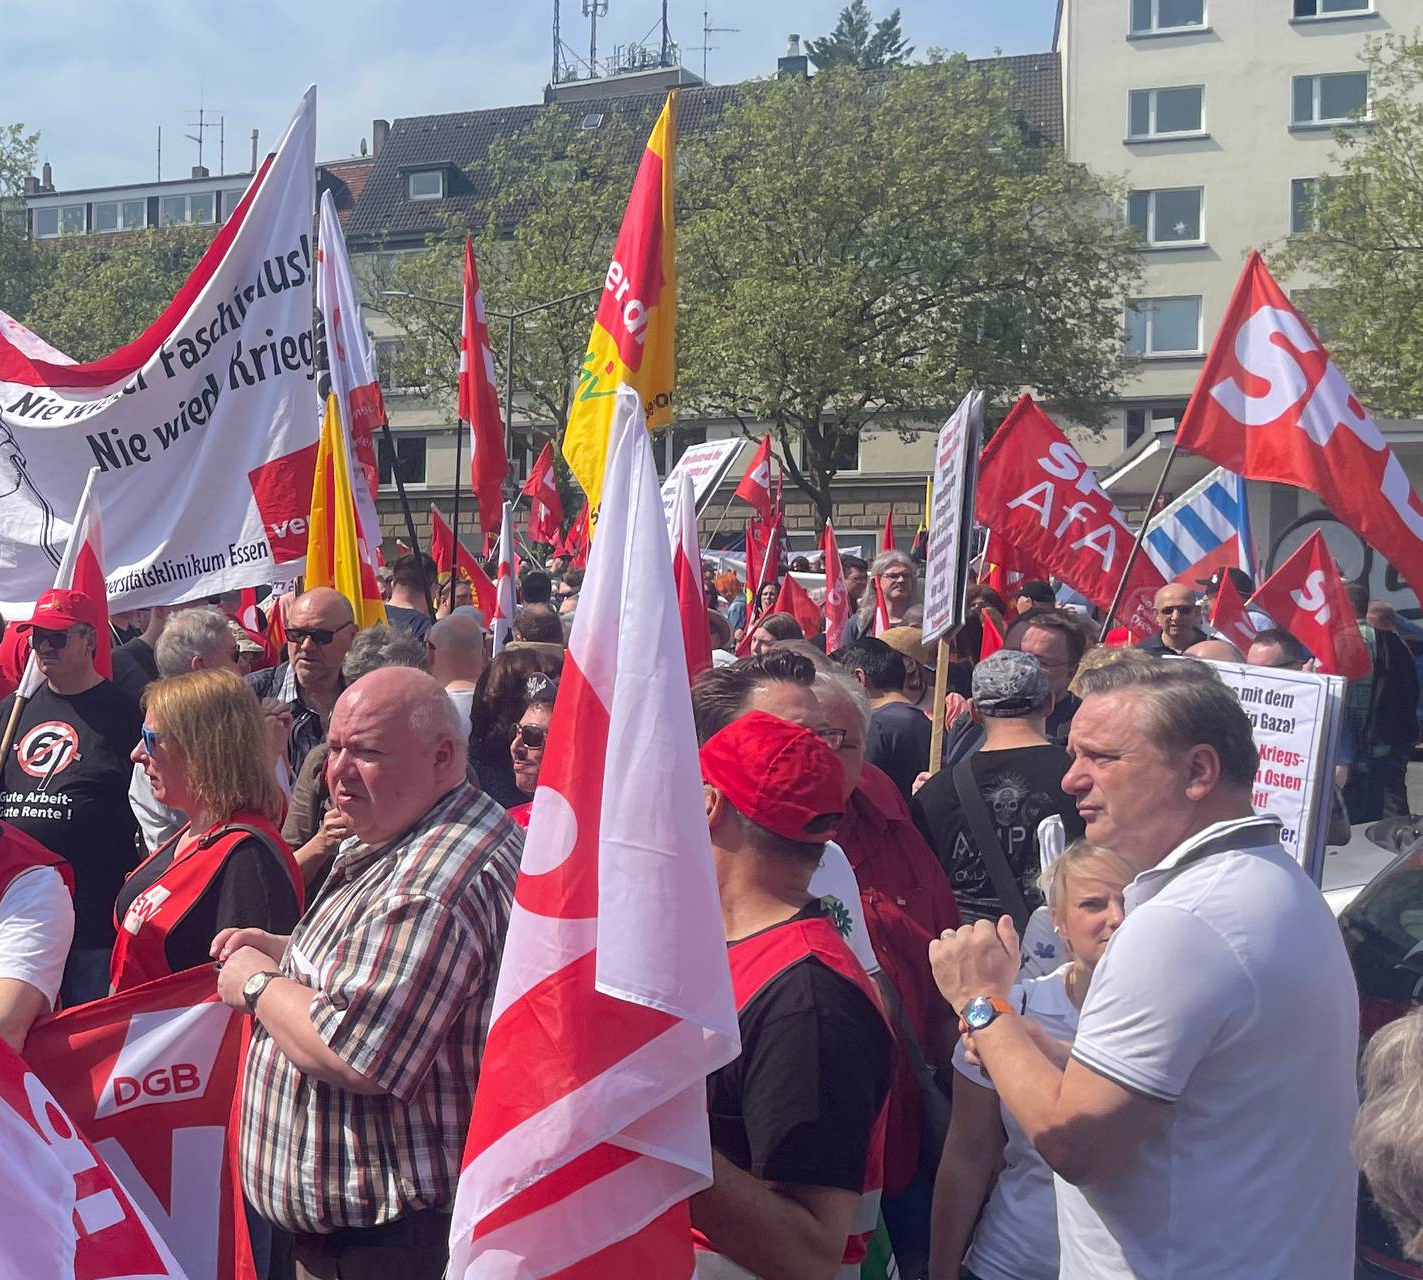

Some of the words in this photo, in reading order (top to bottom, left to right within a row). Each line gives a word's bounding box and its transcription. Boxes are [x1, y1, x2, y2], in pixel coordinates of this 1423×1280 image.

[8, 392, 59, 421] Nie
[86, 428, 152, 472] Nie
[153, 373, 222, 450] wied
[1006, 480, 1117, 574] AfA
[228, 540, 269, 567] Essen
[1241, 686, 1263, 704] mit
[1264, 689, 1295, 709] dem
[1260, 712, 1296, 735] Gaza!
[1259, 743, 1305, 767] Kriegs-
[1264, 769, 1302, 792] Osten
[0, 791, 23, 803] Gute
[24, 791, 73, 805] Arbeit-
[21, 806, 62, 819] Rente
[112, 1063, 201, 1107] DGB
